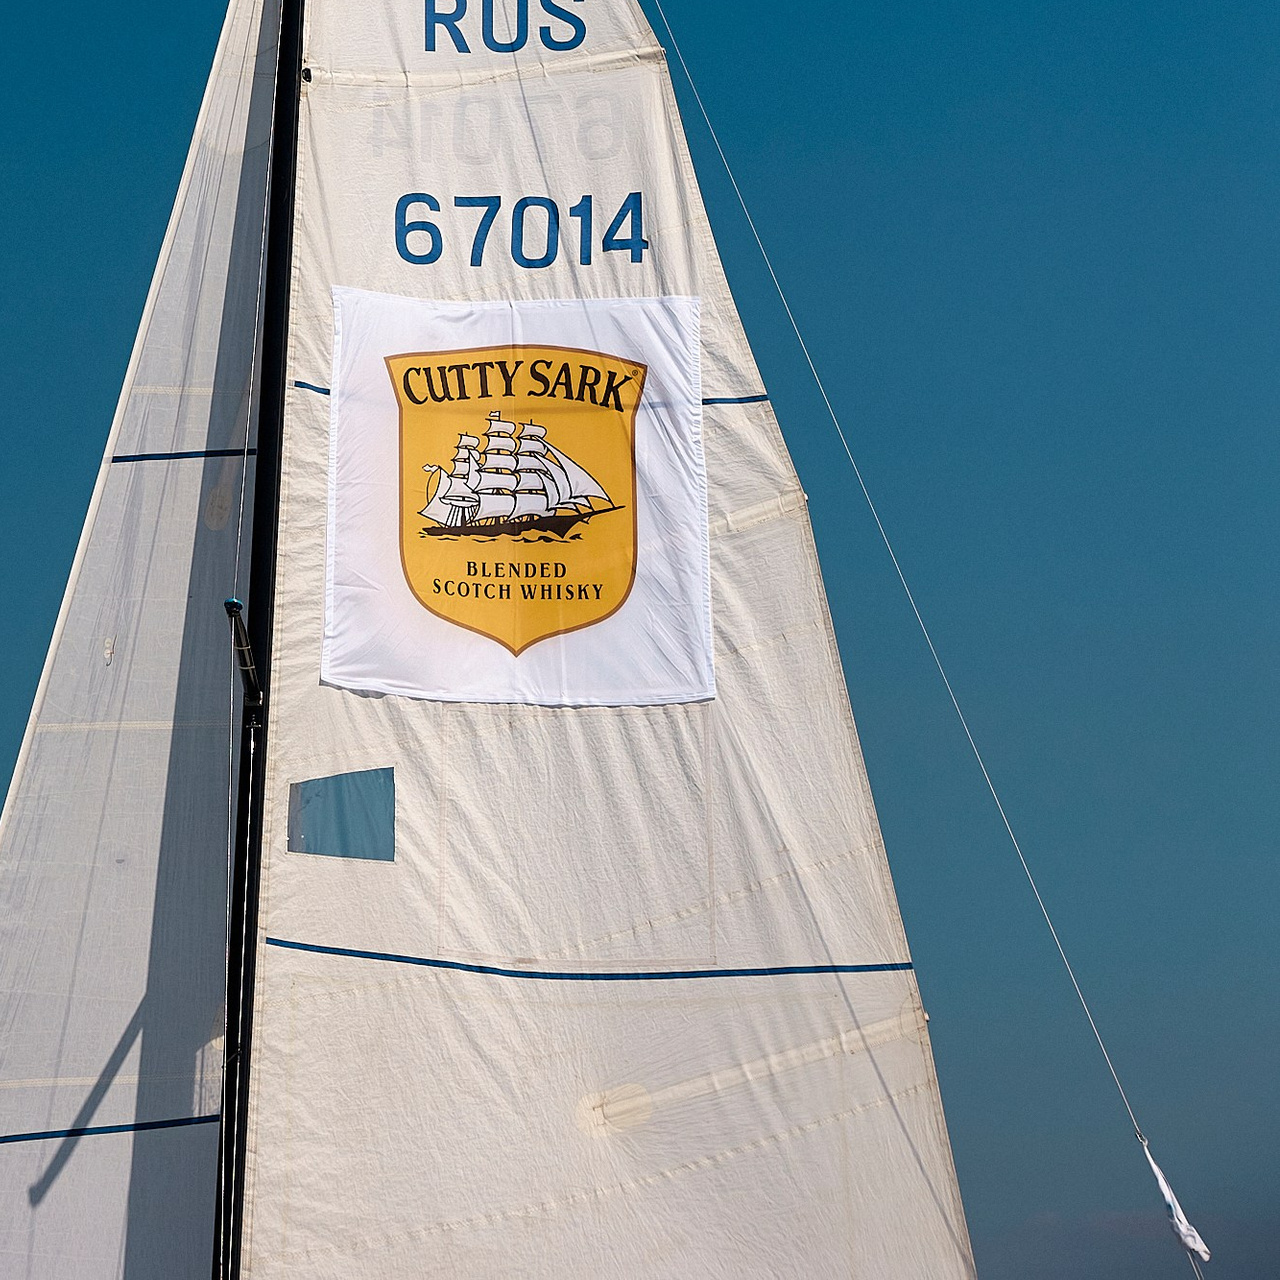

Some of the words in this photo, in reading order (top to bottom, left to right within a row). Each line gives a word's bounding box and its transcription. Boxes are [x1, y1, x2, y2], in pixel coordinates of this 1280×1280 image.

[394, 191, 649, 269] 67014
[403, 360, 523, 405] CUTTY
[527, 361, 632, 413] SARK
[466, 561, 567, 578] BLENDED
[432, 578, 511, 600] SCOTCH
[520, 583, 604, 601] WHISKY
